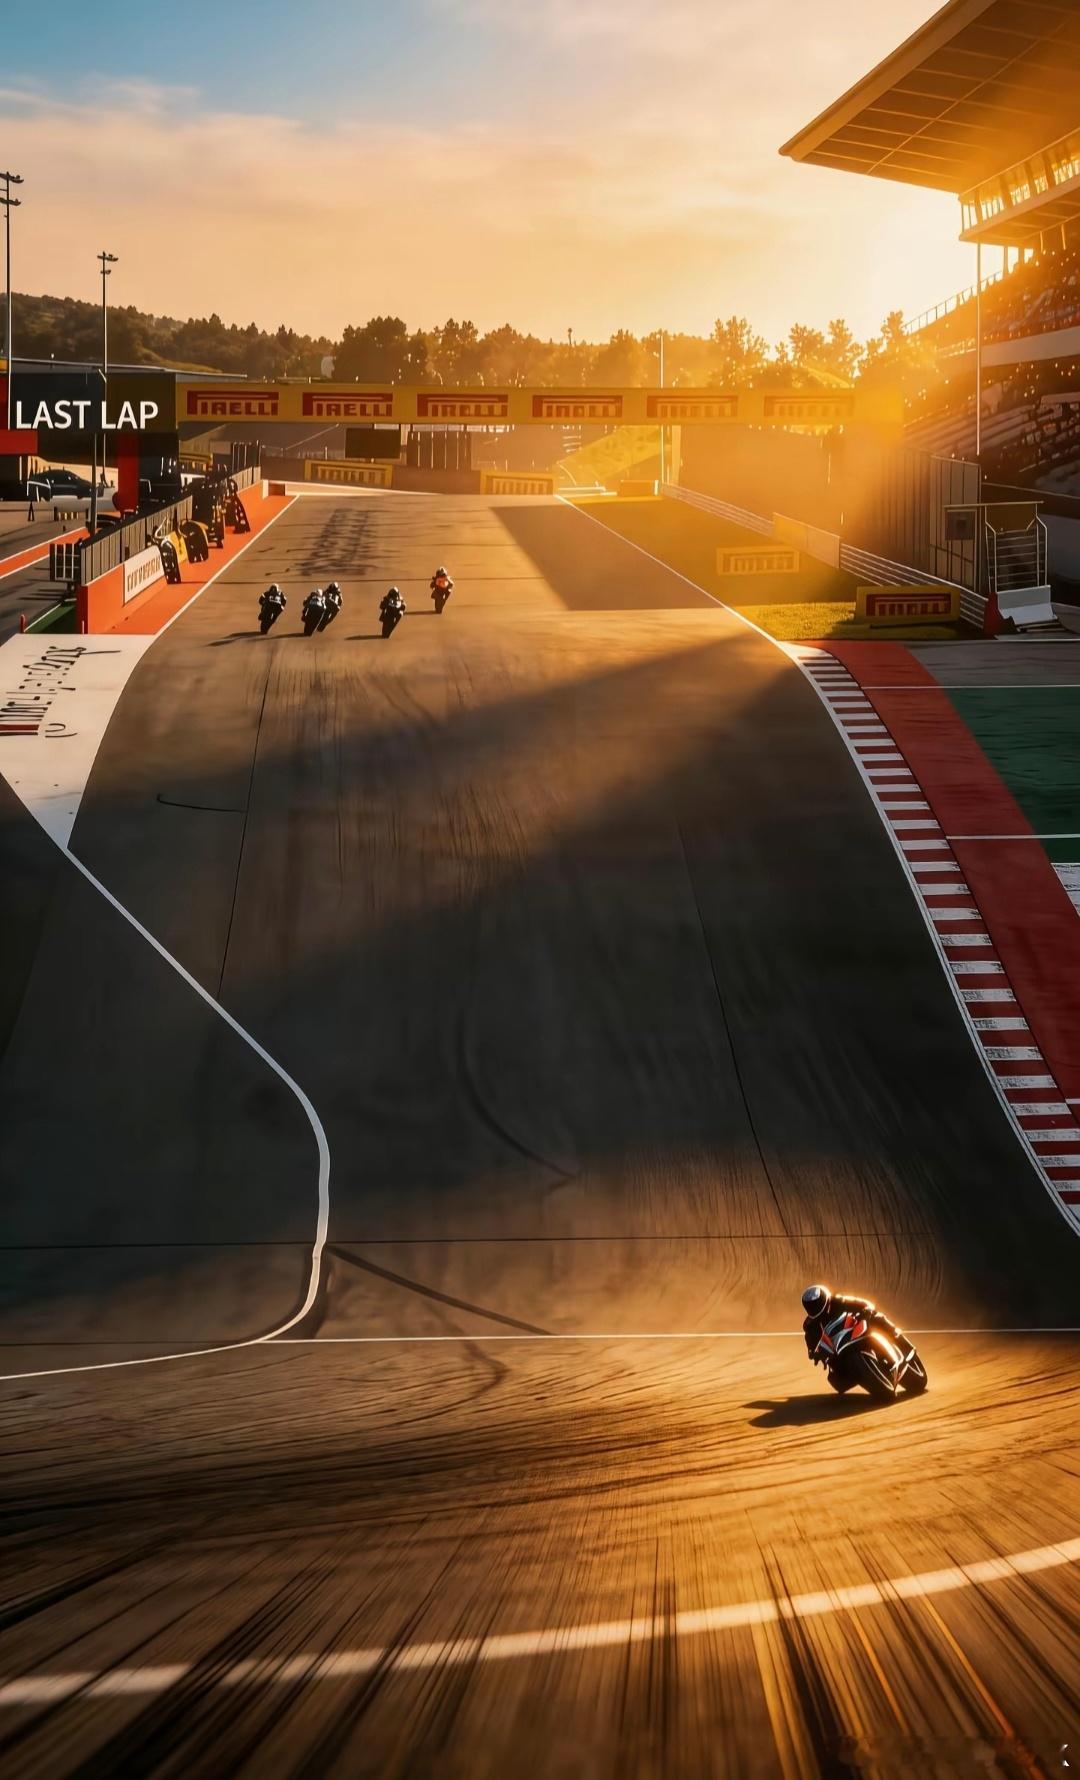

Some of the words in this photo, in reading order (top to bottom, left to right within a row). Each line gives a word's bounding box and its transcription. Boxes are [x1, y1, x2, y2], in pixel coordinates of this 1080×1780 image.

[16, 400, 91, 430] LAST
[101, 401, 159, 430] LAP
[187, 390, 279, 416] PIRELLI
[302, 392, 393, 417] PIRELLI
